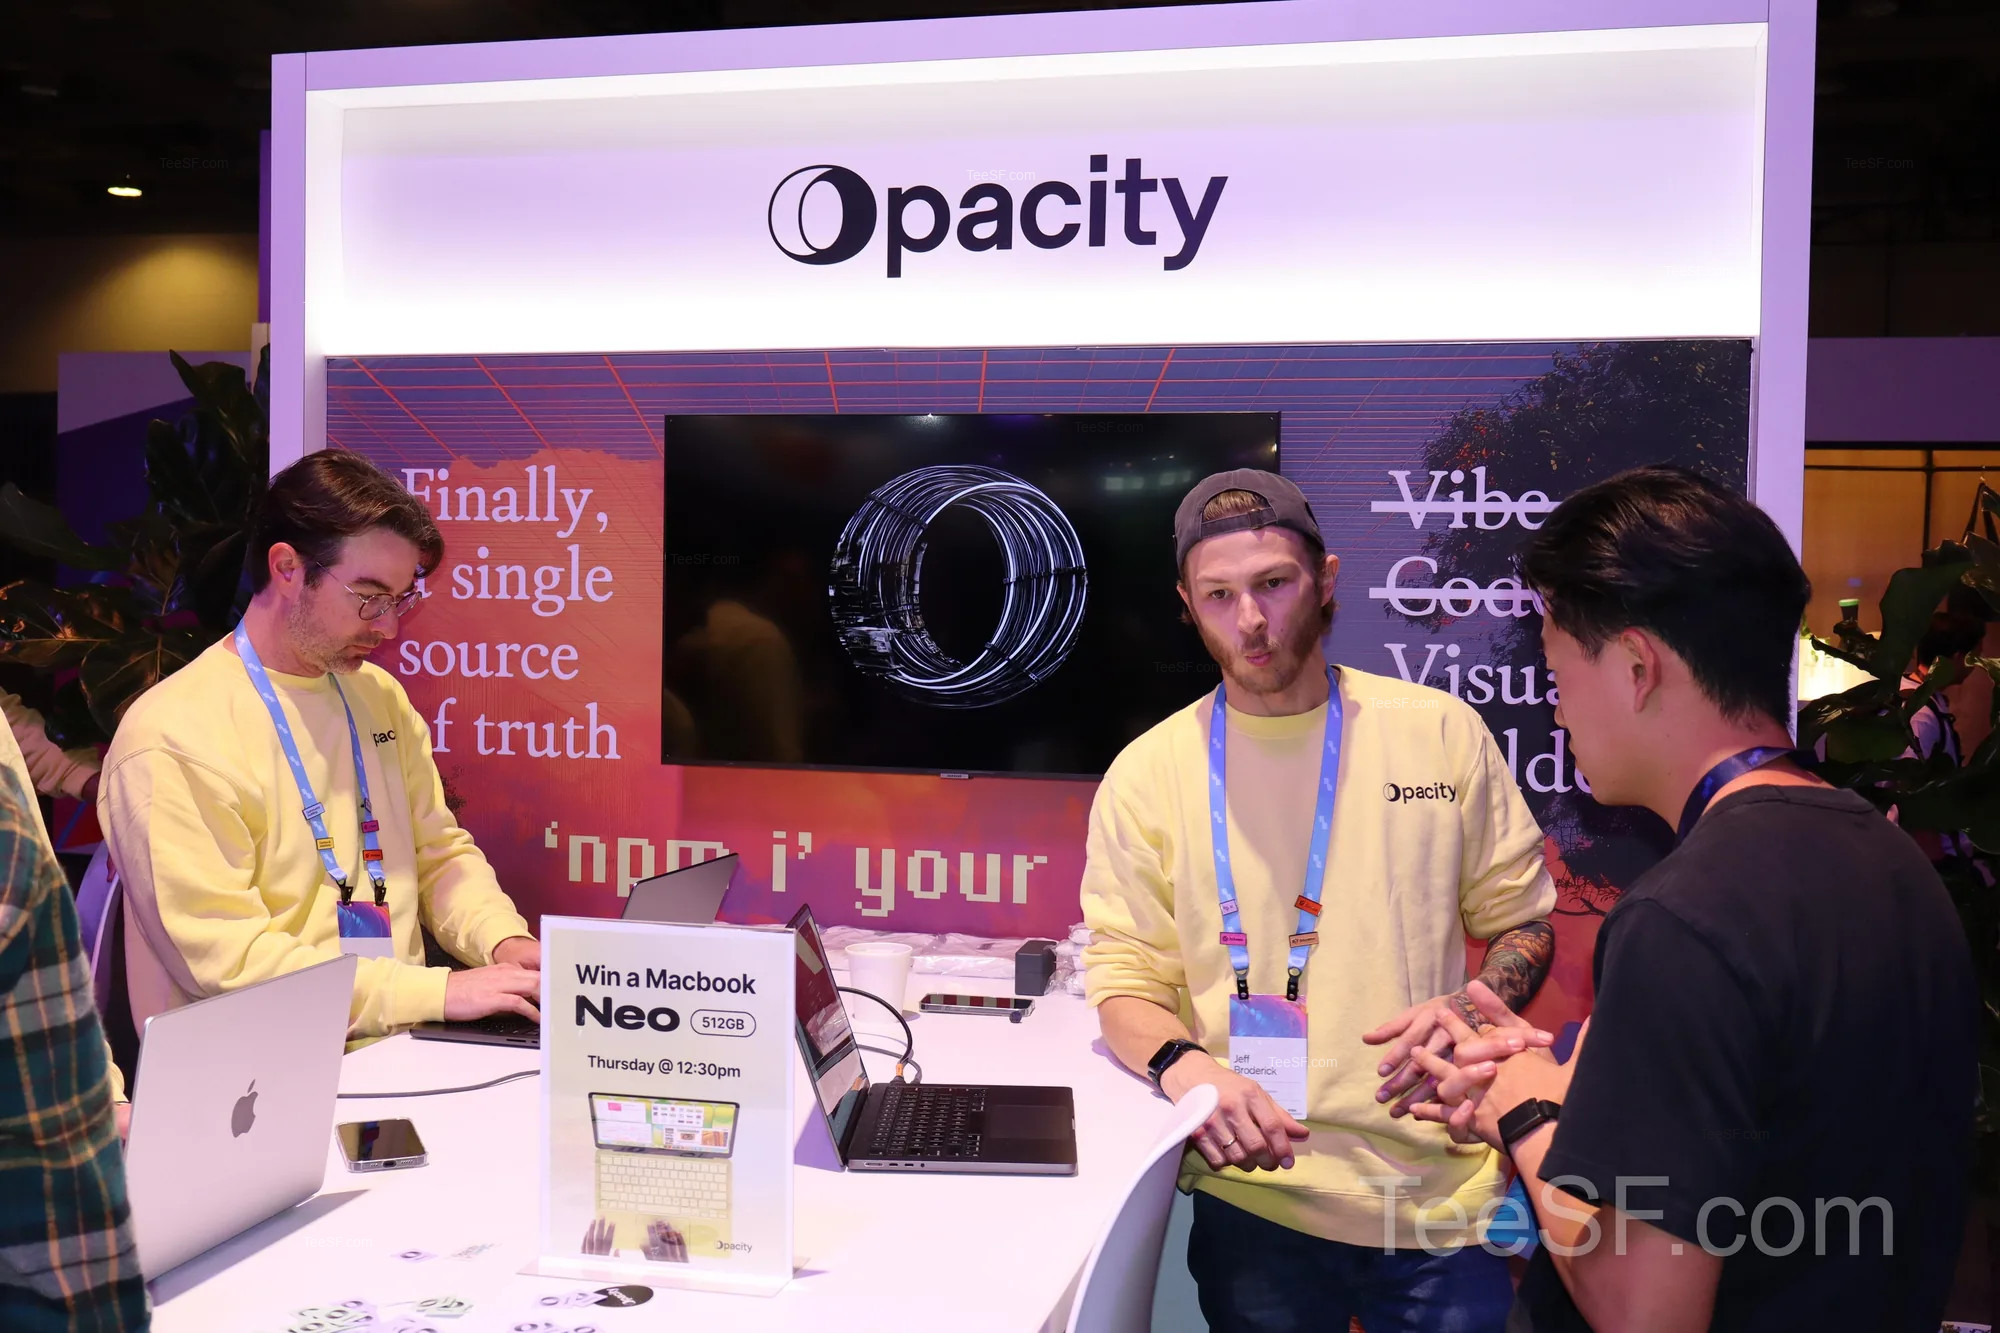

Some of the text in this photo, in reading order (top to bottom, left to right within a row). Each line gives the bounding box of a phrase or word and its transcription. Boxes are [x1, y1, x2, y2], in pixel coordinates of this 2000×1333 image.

[767, 153, 1229, 279] Opacity
[401, 464, 609, 538] Finally,
[1388, 465, 1550, 530] Vibe
[452, 543, 613, 617] single
[1386, 556, 1546, 618] Cod
[399, 639, 579, 680] source
[1383, 643, 1561, 706] Visu
[432, 696, 622, 760] f truth
[1383, 782, 1457, 804] Opacity
[855, 846, 1048, 917] your
[575, 964, 757, 995] Win a Macbook
[575, 994, 746, 1033] Neo 512GB
[587, 1054, 742, 1079] Thursday @ 12:30pm
[1234, 1054, 1251, 1064] Jeff
[1234, 1065, 1278, 1076] Broderick
